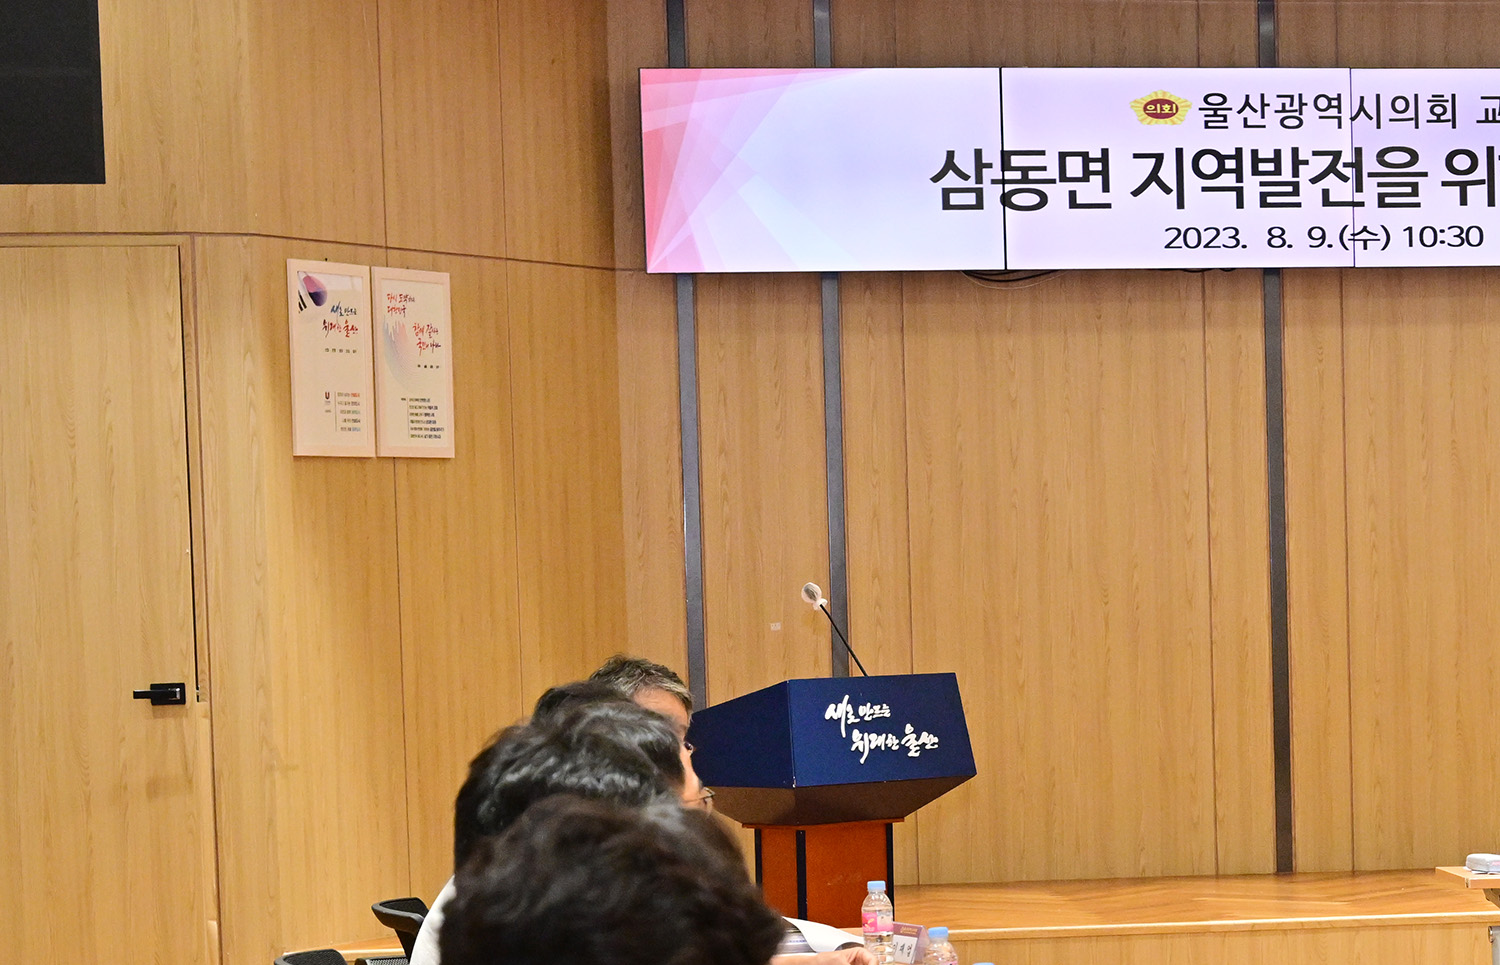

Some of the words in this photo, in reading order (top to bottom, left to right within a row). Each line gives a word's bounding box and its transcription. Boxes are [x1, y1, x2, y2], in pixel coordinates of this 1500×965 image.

[1145, 103, 1177, 114] 의회
[1198, 92, 1457, 130] 울산광역시의회
[929, 147, 1112, 212] 삼동면
[1130, 146, 1429, 211] 지역발전을
[1164, 226, 1248, 250] 2023.
[1267, 226, 1293, 249] 8.
[1403, 225, 1484, 248] 10:30
[824, 694, 860, 738] 새로
[858, 702, 892, 721] 만드는
[850, 728, 900, 765] 위대한
[900, 723, 939, 758] 울산
